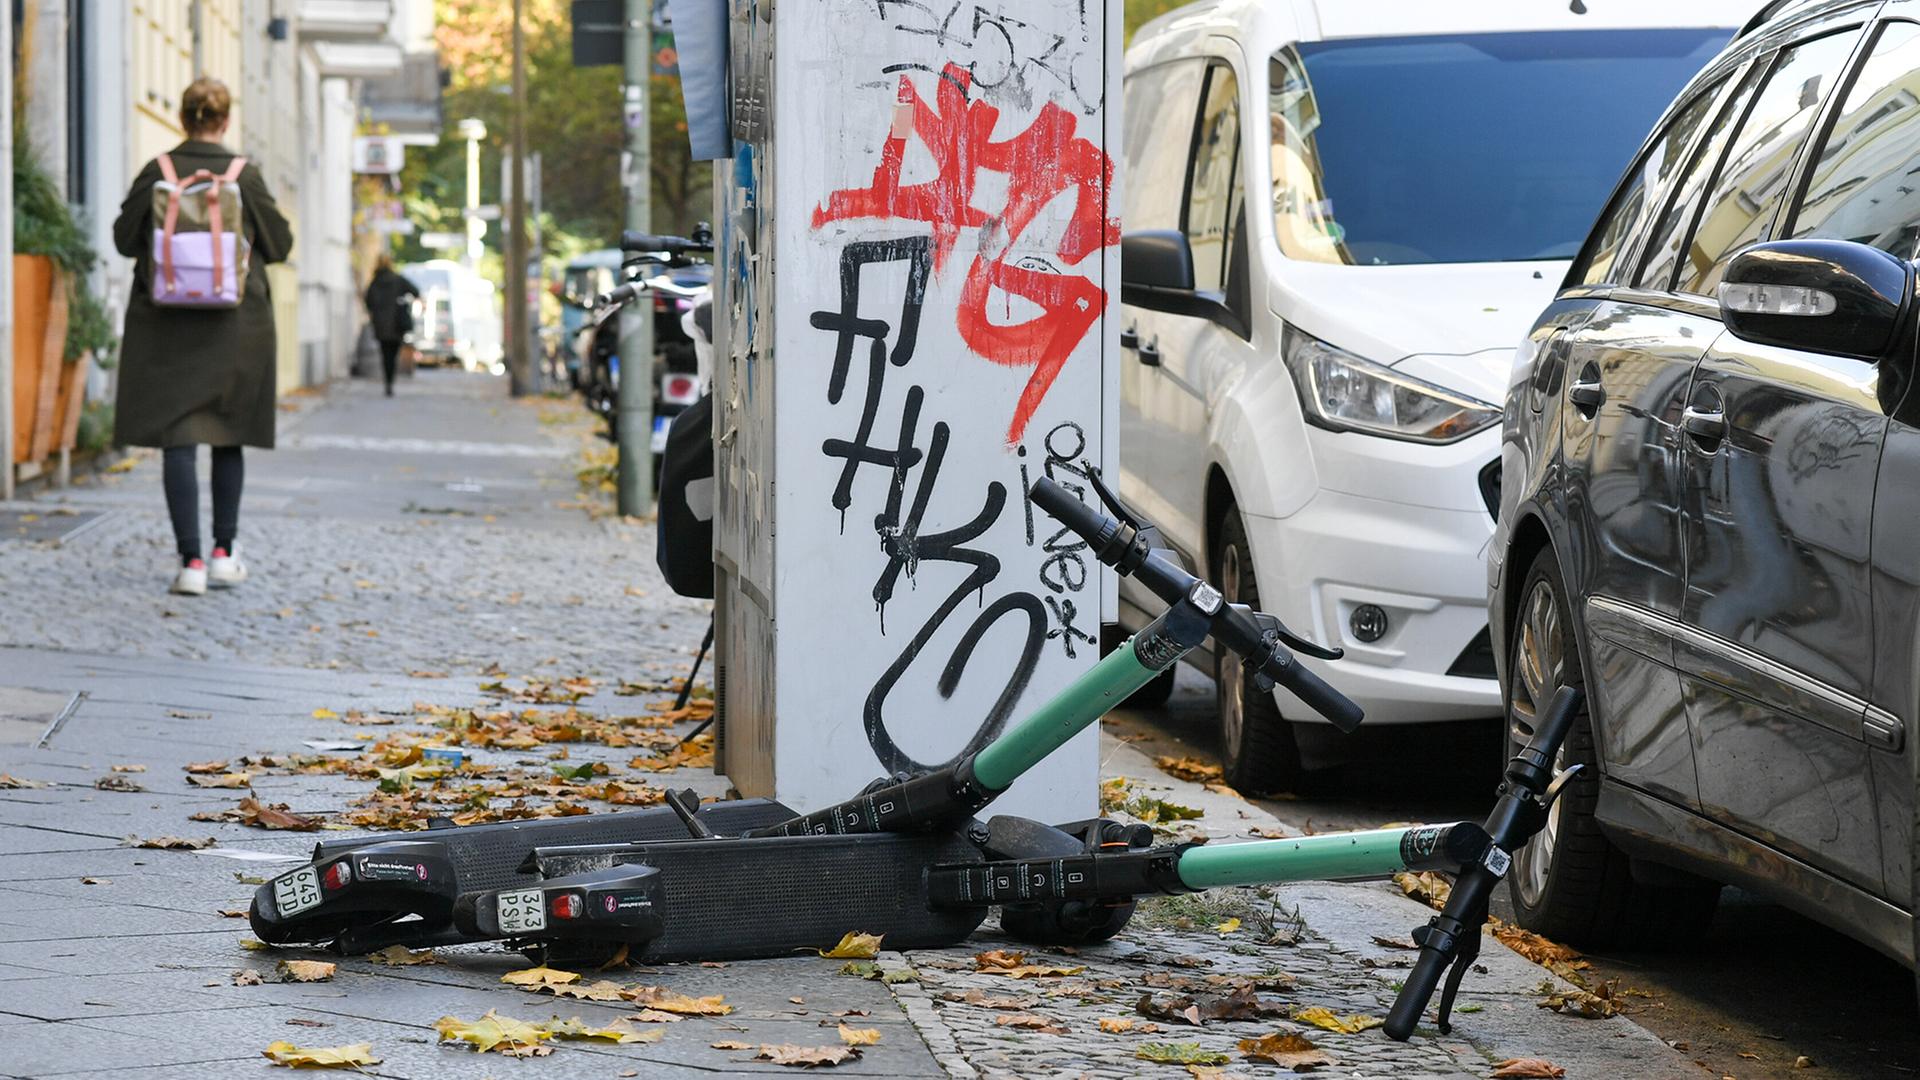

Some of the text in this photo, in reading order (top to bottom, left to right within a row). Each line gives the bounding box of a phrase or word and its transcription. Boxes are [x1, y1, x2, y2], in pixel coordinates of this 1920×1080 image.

[277, 875, 298, 912] PTD
[297, 871, 319, 905] 645
[522, 894, 542, 928] 343
